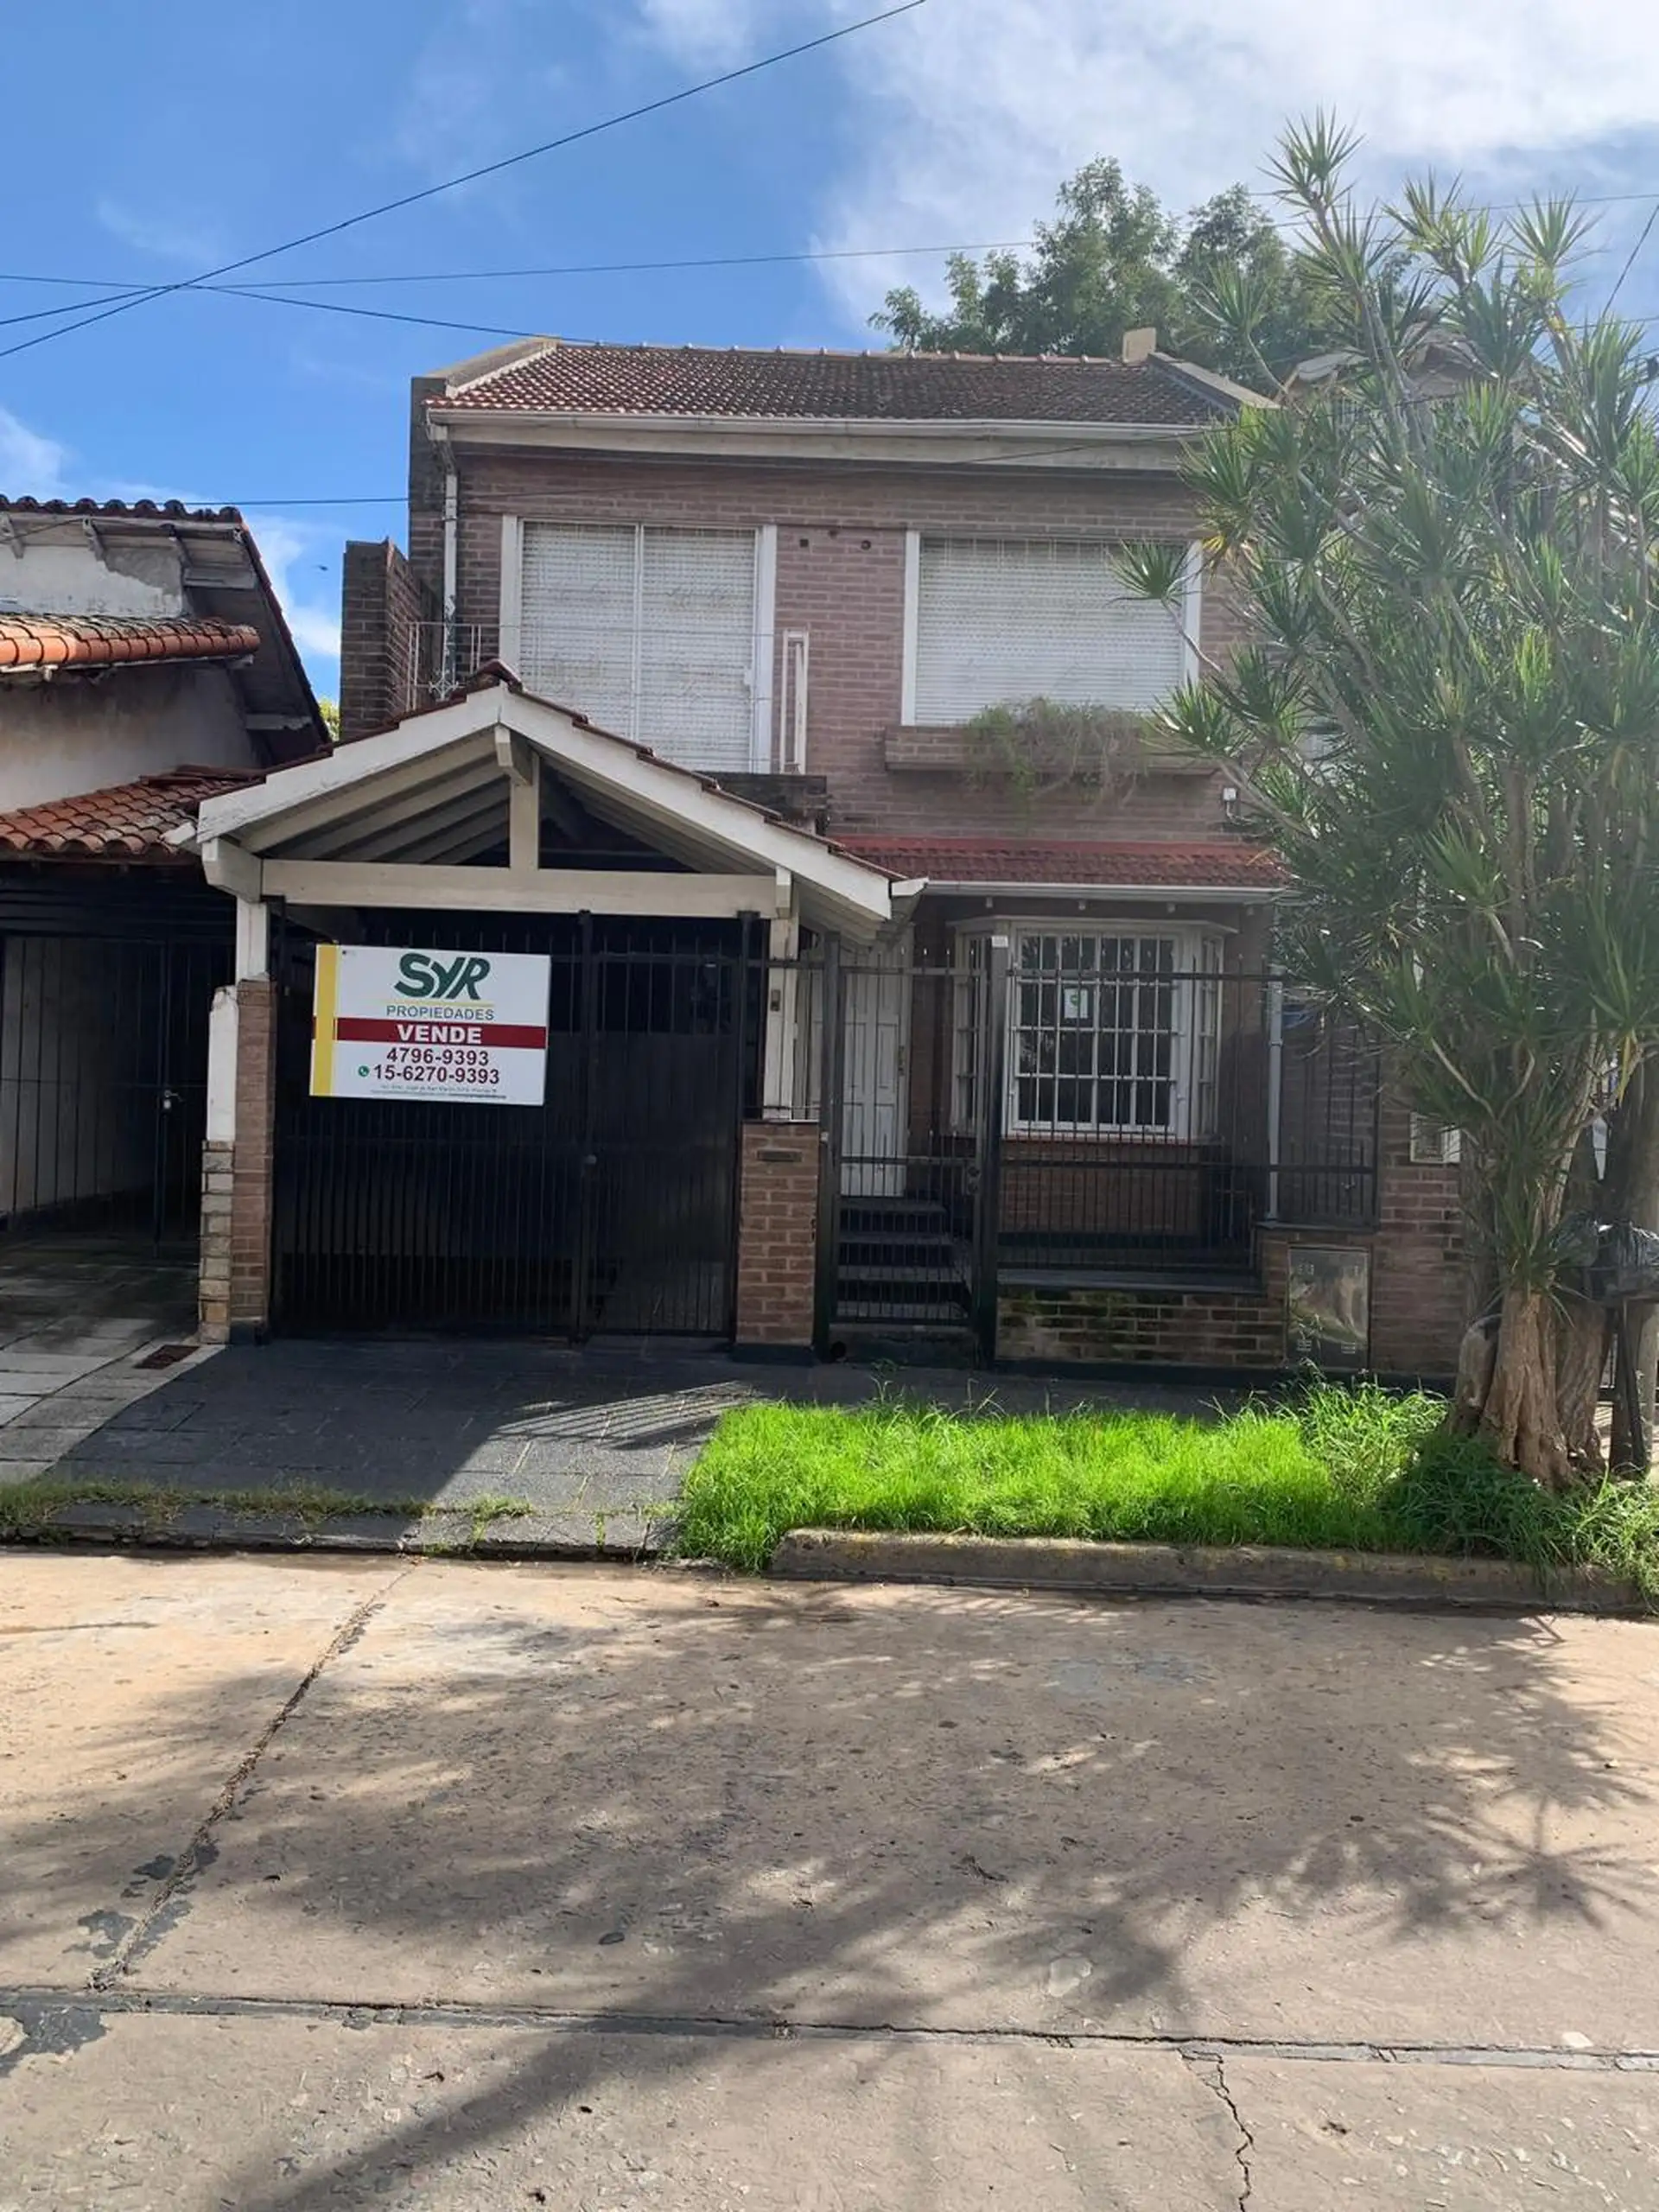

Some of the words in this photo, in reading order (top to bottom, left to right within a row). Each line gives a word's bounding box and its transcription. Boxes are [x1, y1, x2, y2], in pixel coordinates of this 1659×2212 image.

[394, 953, 491, 1000] SYR
[386, 1006, 494, 1020] PROPIEDADES
[397, 1024, 481, 1044] VENDE
[386, 1047, 489, 1066] 4796-9393
[373, 1065, 499, 1084] 15-6270-9393
